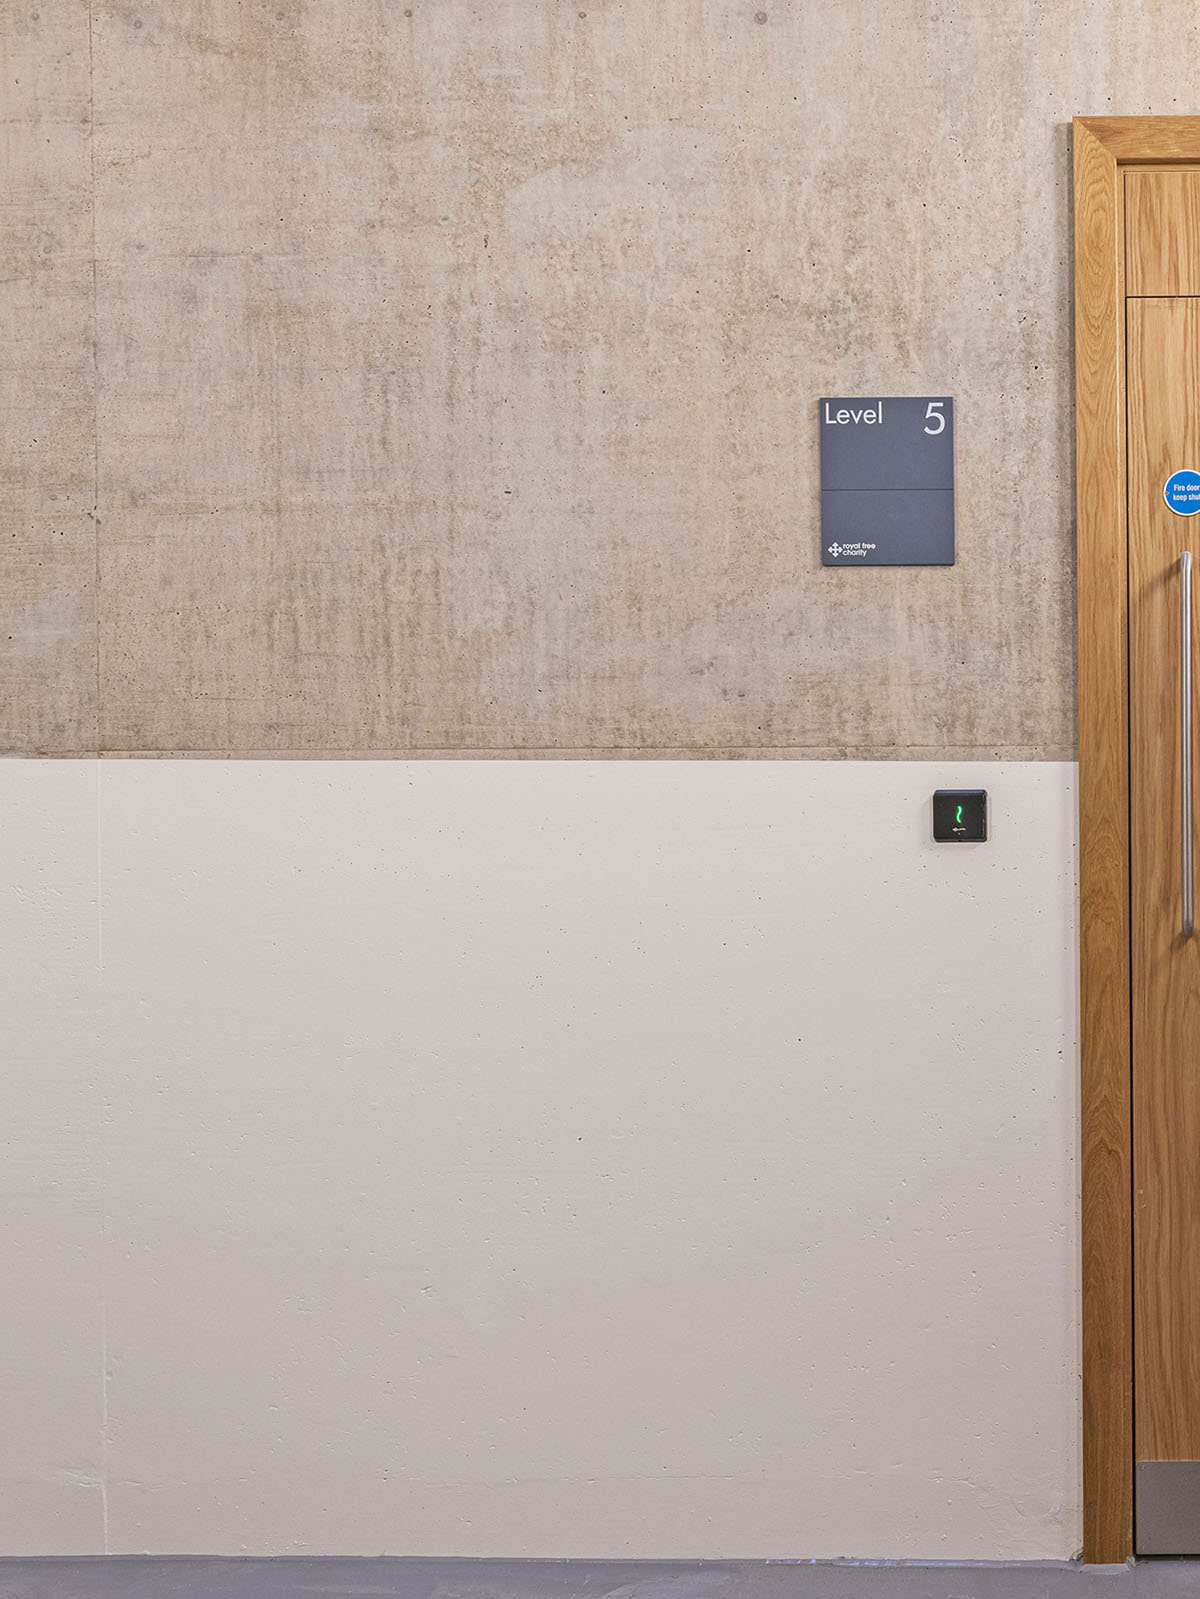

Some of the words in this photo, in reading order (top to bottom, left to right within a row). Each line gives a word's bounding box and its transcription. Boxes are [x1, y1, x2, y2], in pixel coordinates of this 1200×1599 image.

[825, 401, 882, 424] Level
[924, 402, 946, 435] 5
[1173, 494, 1187, 502] keep
[843, 549, 867, 557] charity
